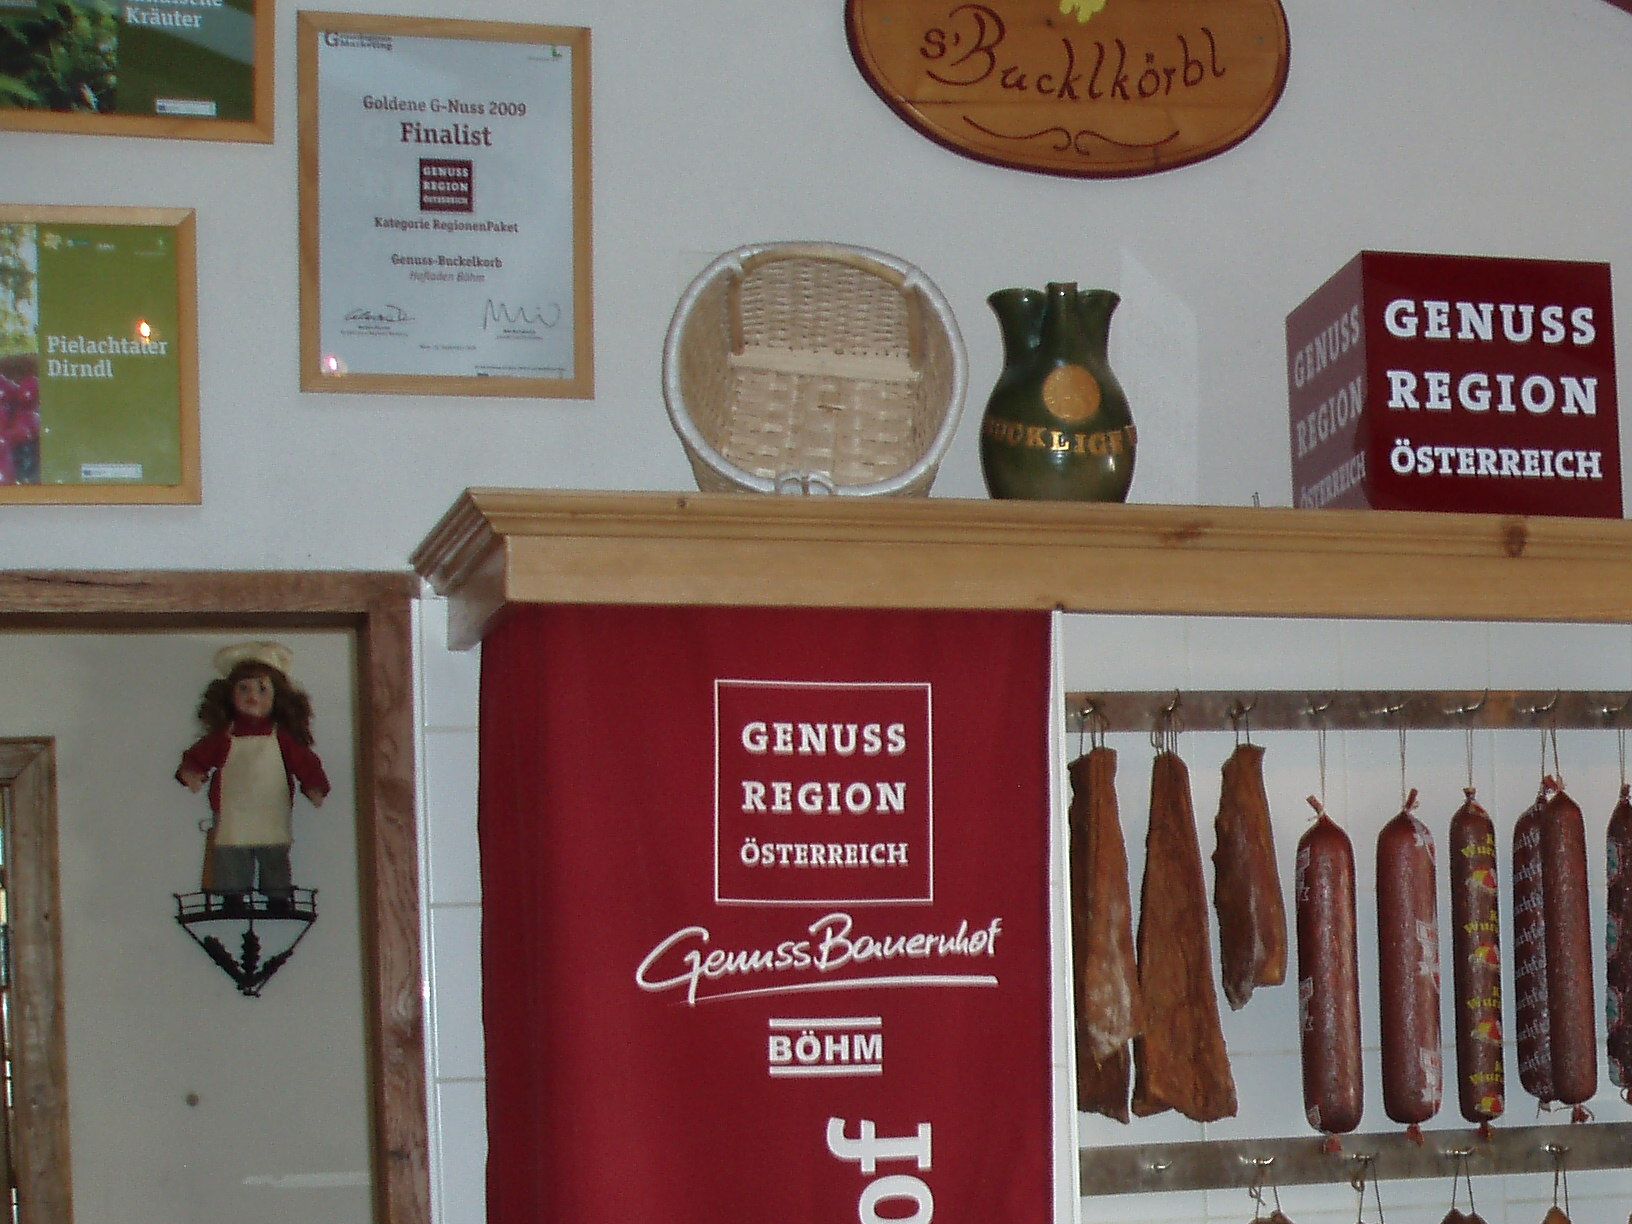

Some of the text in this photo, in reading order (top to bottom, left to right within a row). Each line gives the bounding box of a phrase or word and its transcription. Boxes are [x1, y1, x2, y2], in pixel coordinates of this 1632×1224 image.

[126, 7, 202, 28] Kräuter
[362, 94, 528, 117] Goldene G-Nuss 2009
[400, 121, 494, 147] Finalist
[422, 180, 470, 192] REGION
[374, 216, 519, 234] Kategorie RegionenPaket
[1384, 299, 1597, 346] GENUSS
[1294, 304, 1361, 389] GENUSS
[47, 359, 114, 378] Dirndl
[1386, 370, 1598, 416] REGION
[1297, 376, 1364, 457] REGION
[1390, 438, 1603, 479] ÖSTERREICH
[741, 721, 907, 756] GENUSS
[741, 780, 907, 815] REGION
[740, 837, 909, 868] ÖSTERREICH
[768, 1029, 884, 1063] BÖHM
